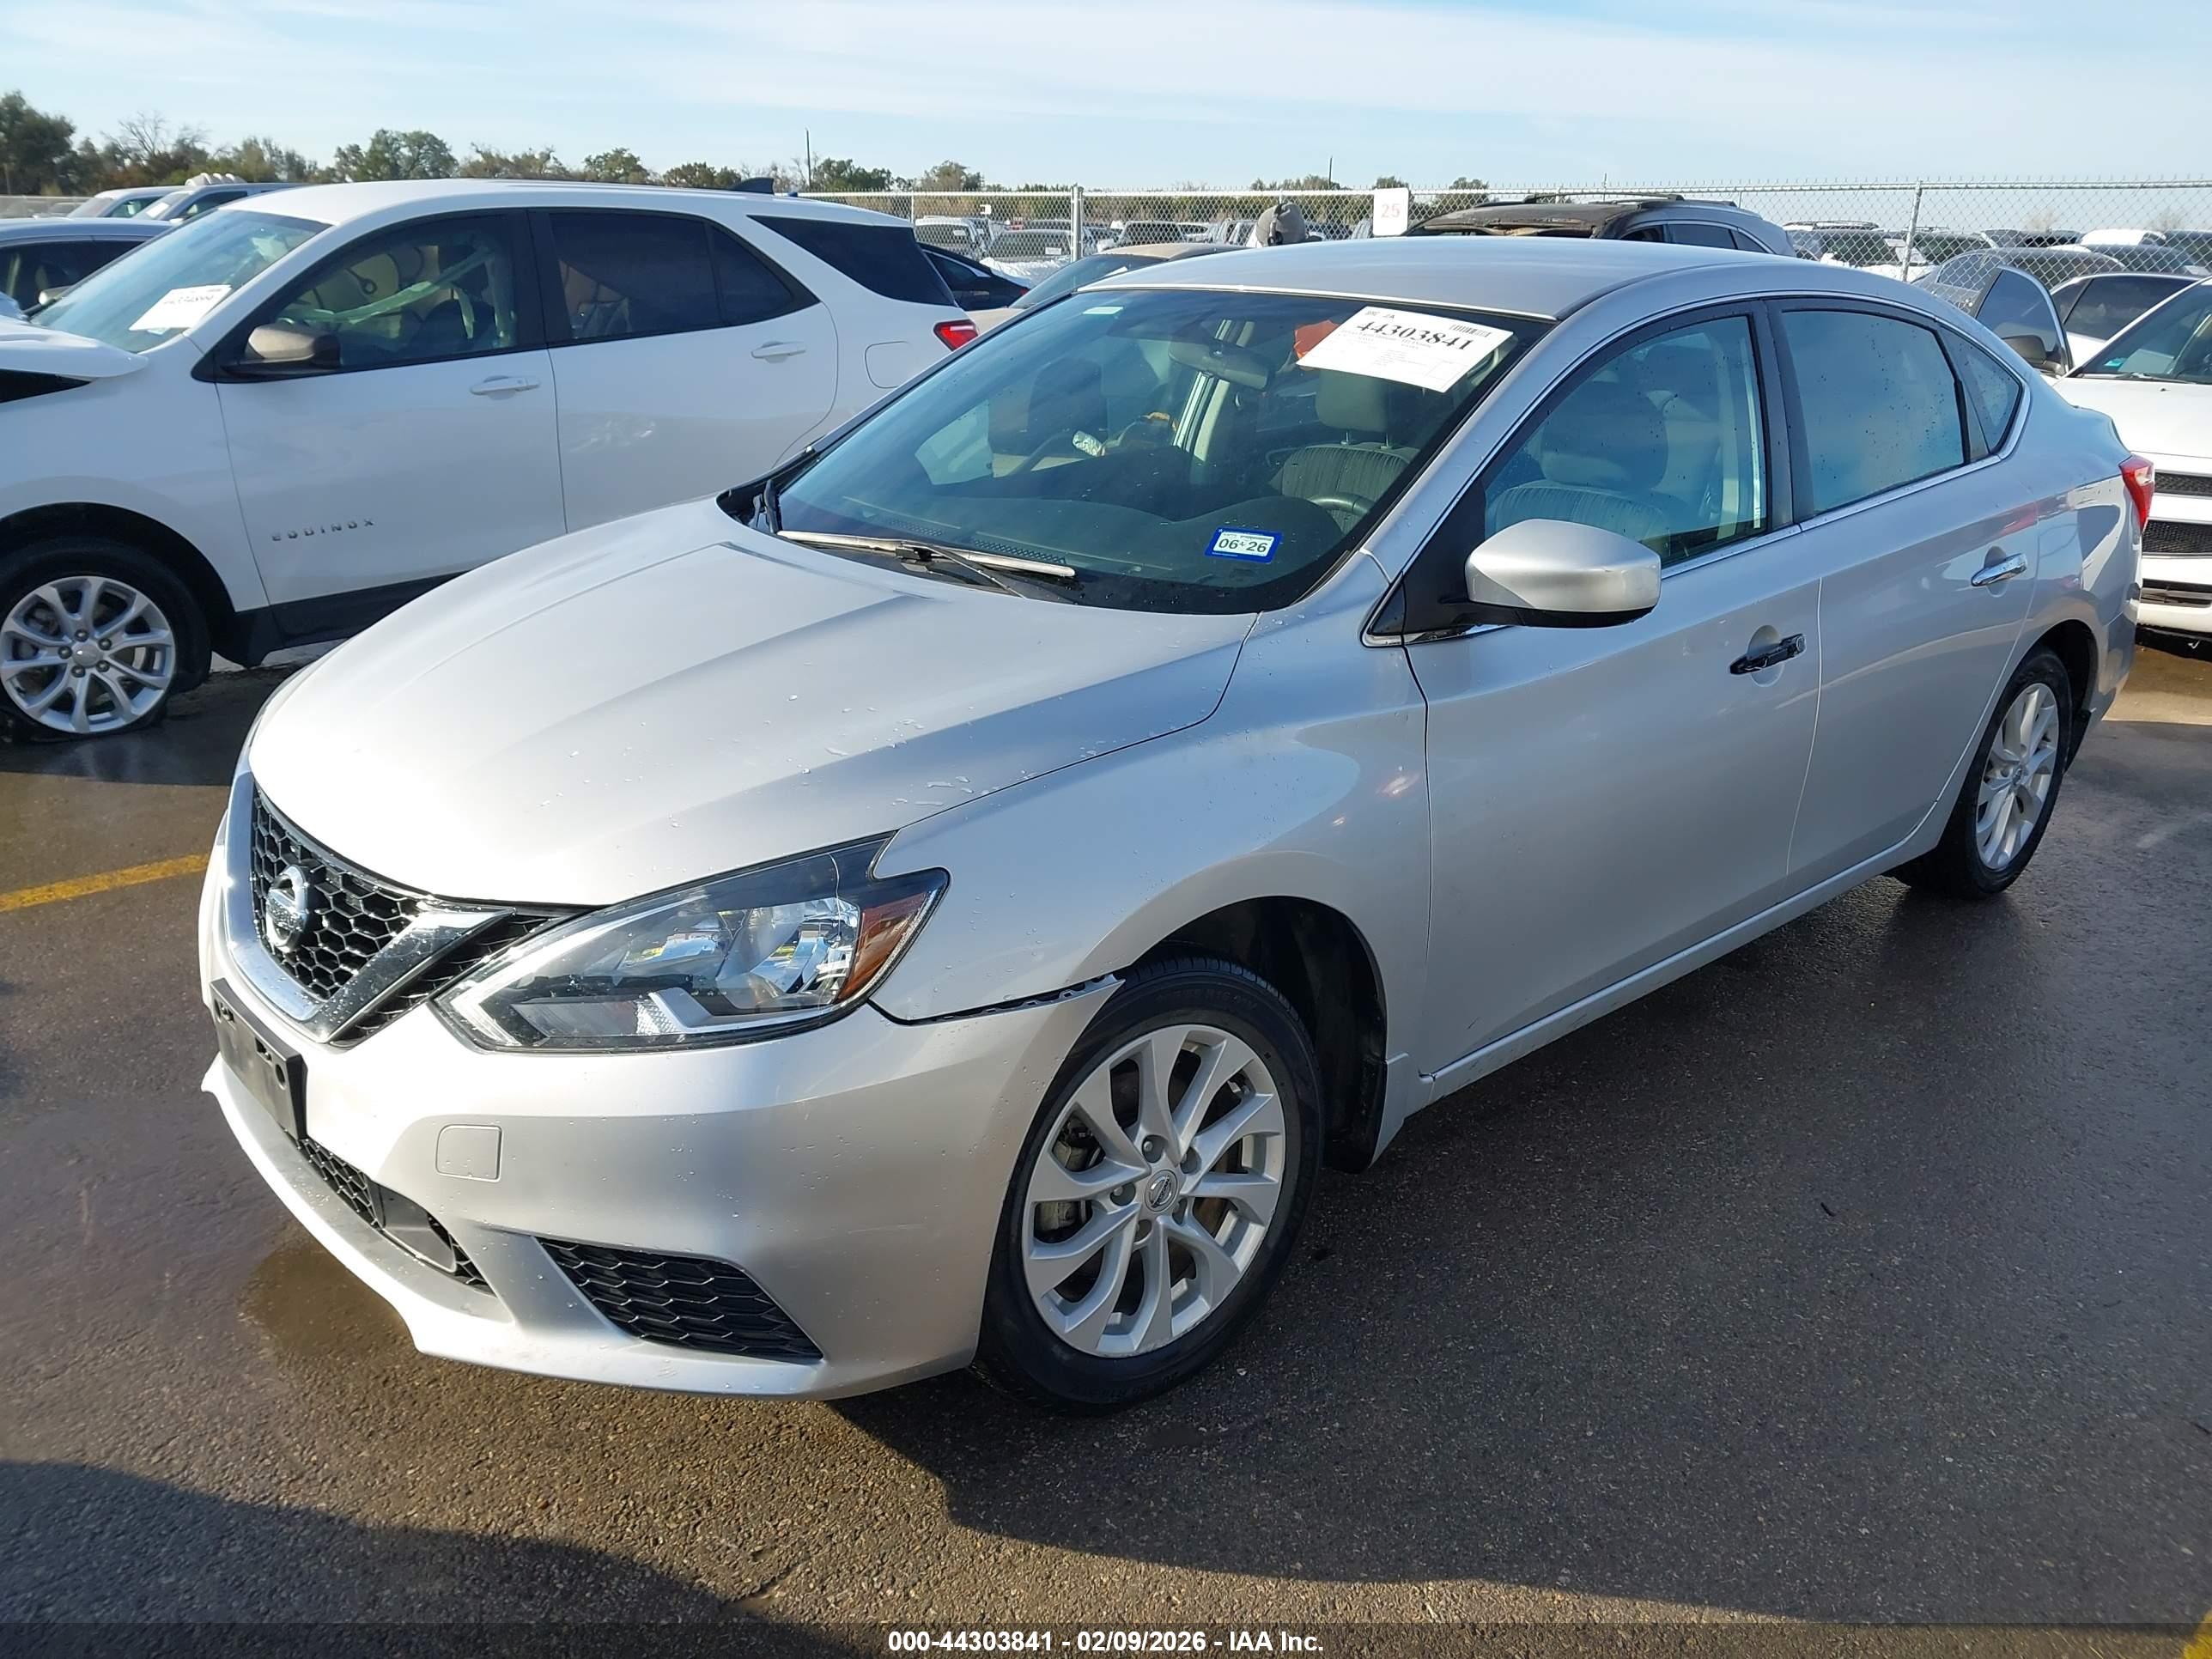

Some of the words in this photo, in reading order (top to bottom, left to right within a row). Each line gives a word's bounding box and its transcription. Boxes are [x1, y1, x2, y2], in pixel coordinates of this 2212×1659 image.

[1381, 203, 1401, 218] 25
[1357, 320, 1474, 350] 44303841
[271, 518, 374, 542] EQUINOX
[1218, 538, 1239, 550] 06
[1246, 541, 1268, 552] 26
